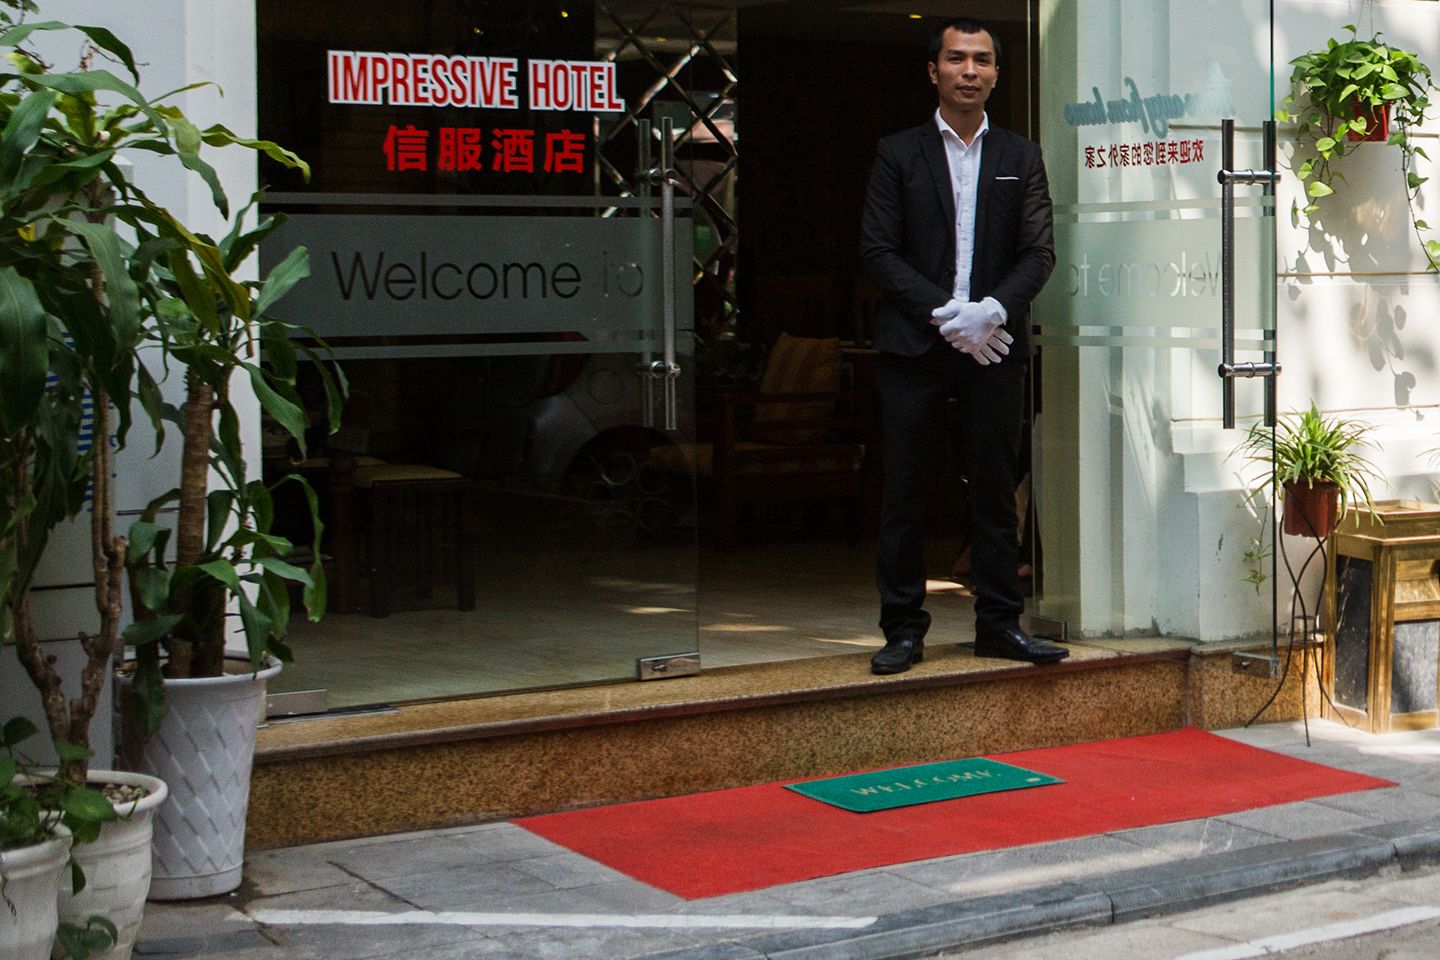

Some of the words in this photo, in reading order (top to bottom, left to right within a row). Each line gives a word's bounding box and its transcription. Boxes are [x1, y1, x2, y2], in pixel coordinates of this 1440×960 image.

[327, 50, 519, 110] IMPRESSIVE
[528, 58, 626, 113] HOTEL
[383, 124, 587, 174] 信服酒店
[330, 250, 581, 301] Welcome
